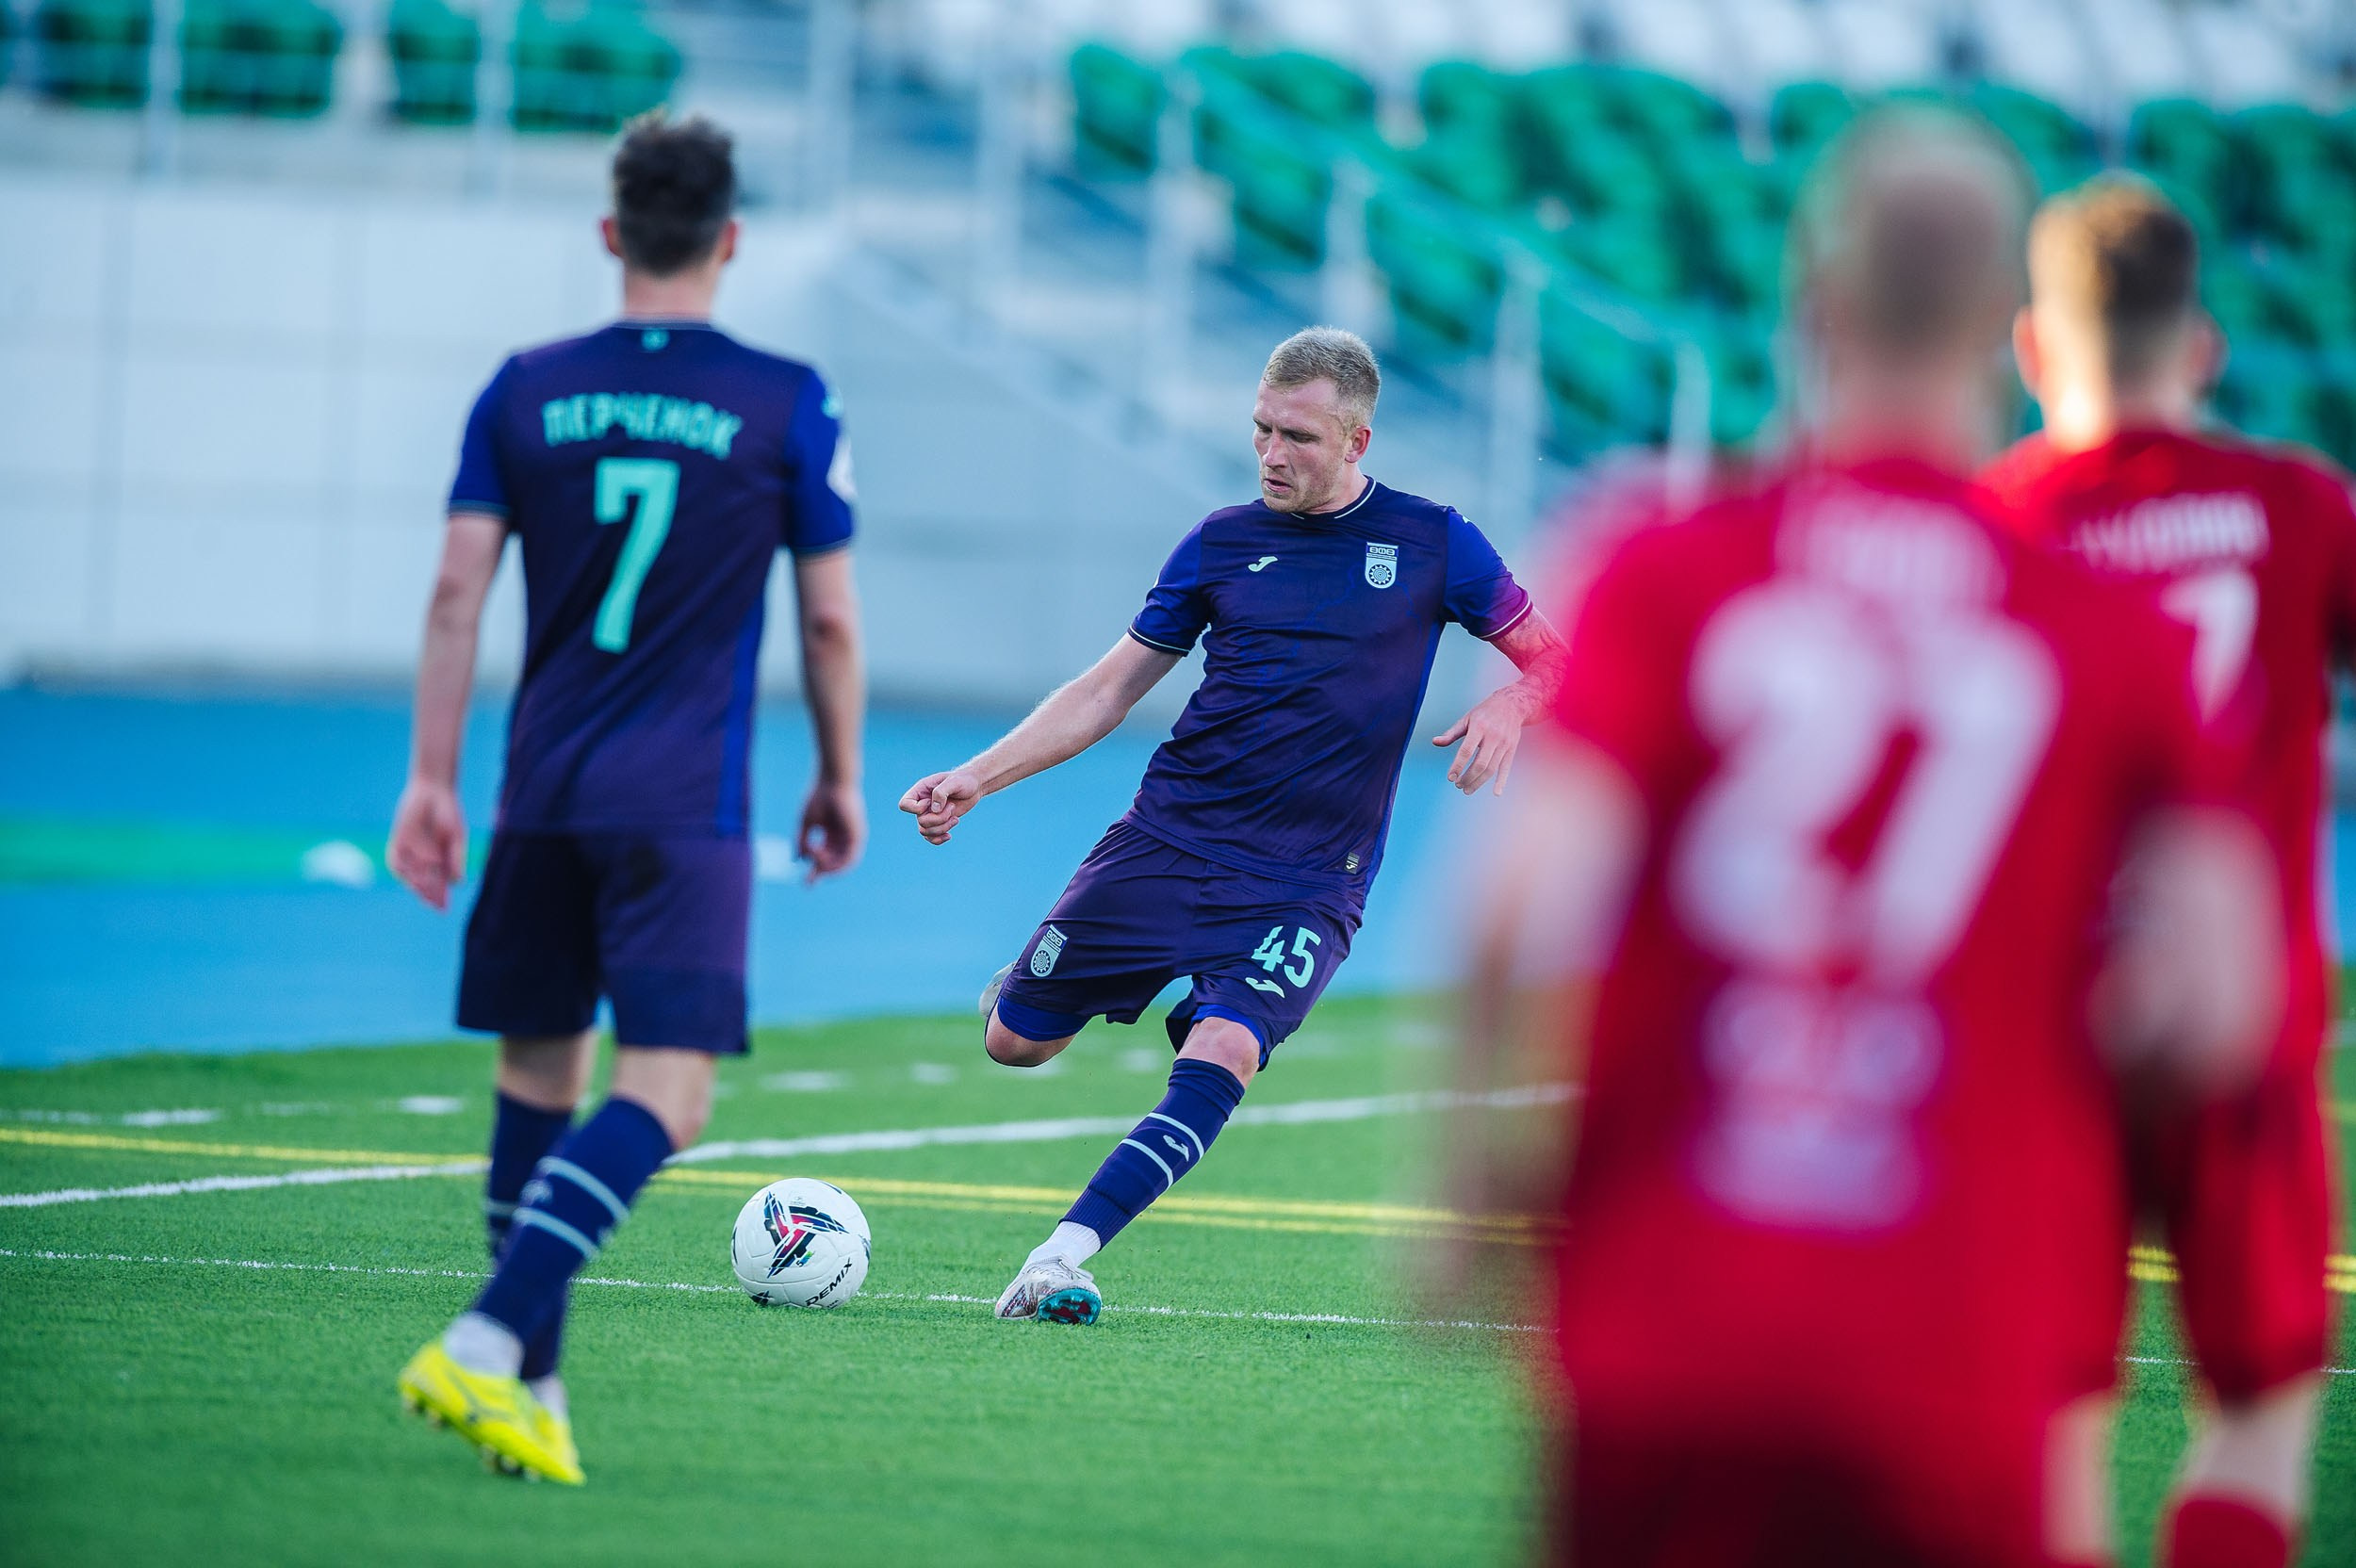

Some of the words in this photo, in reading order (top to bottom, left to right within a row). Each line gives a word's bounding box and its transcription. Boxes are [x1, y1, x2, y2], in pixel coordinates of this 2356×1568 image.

[542, 391, 743, 461] ПЕРЧЕНОК
[592, 457, 681, 653] 7
[1670, 586, 2064, 980] 27
[1251, 925, 1321, 988] 45
[805, 1257, 853, 1307] DEMIX
